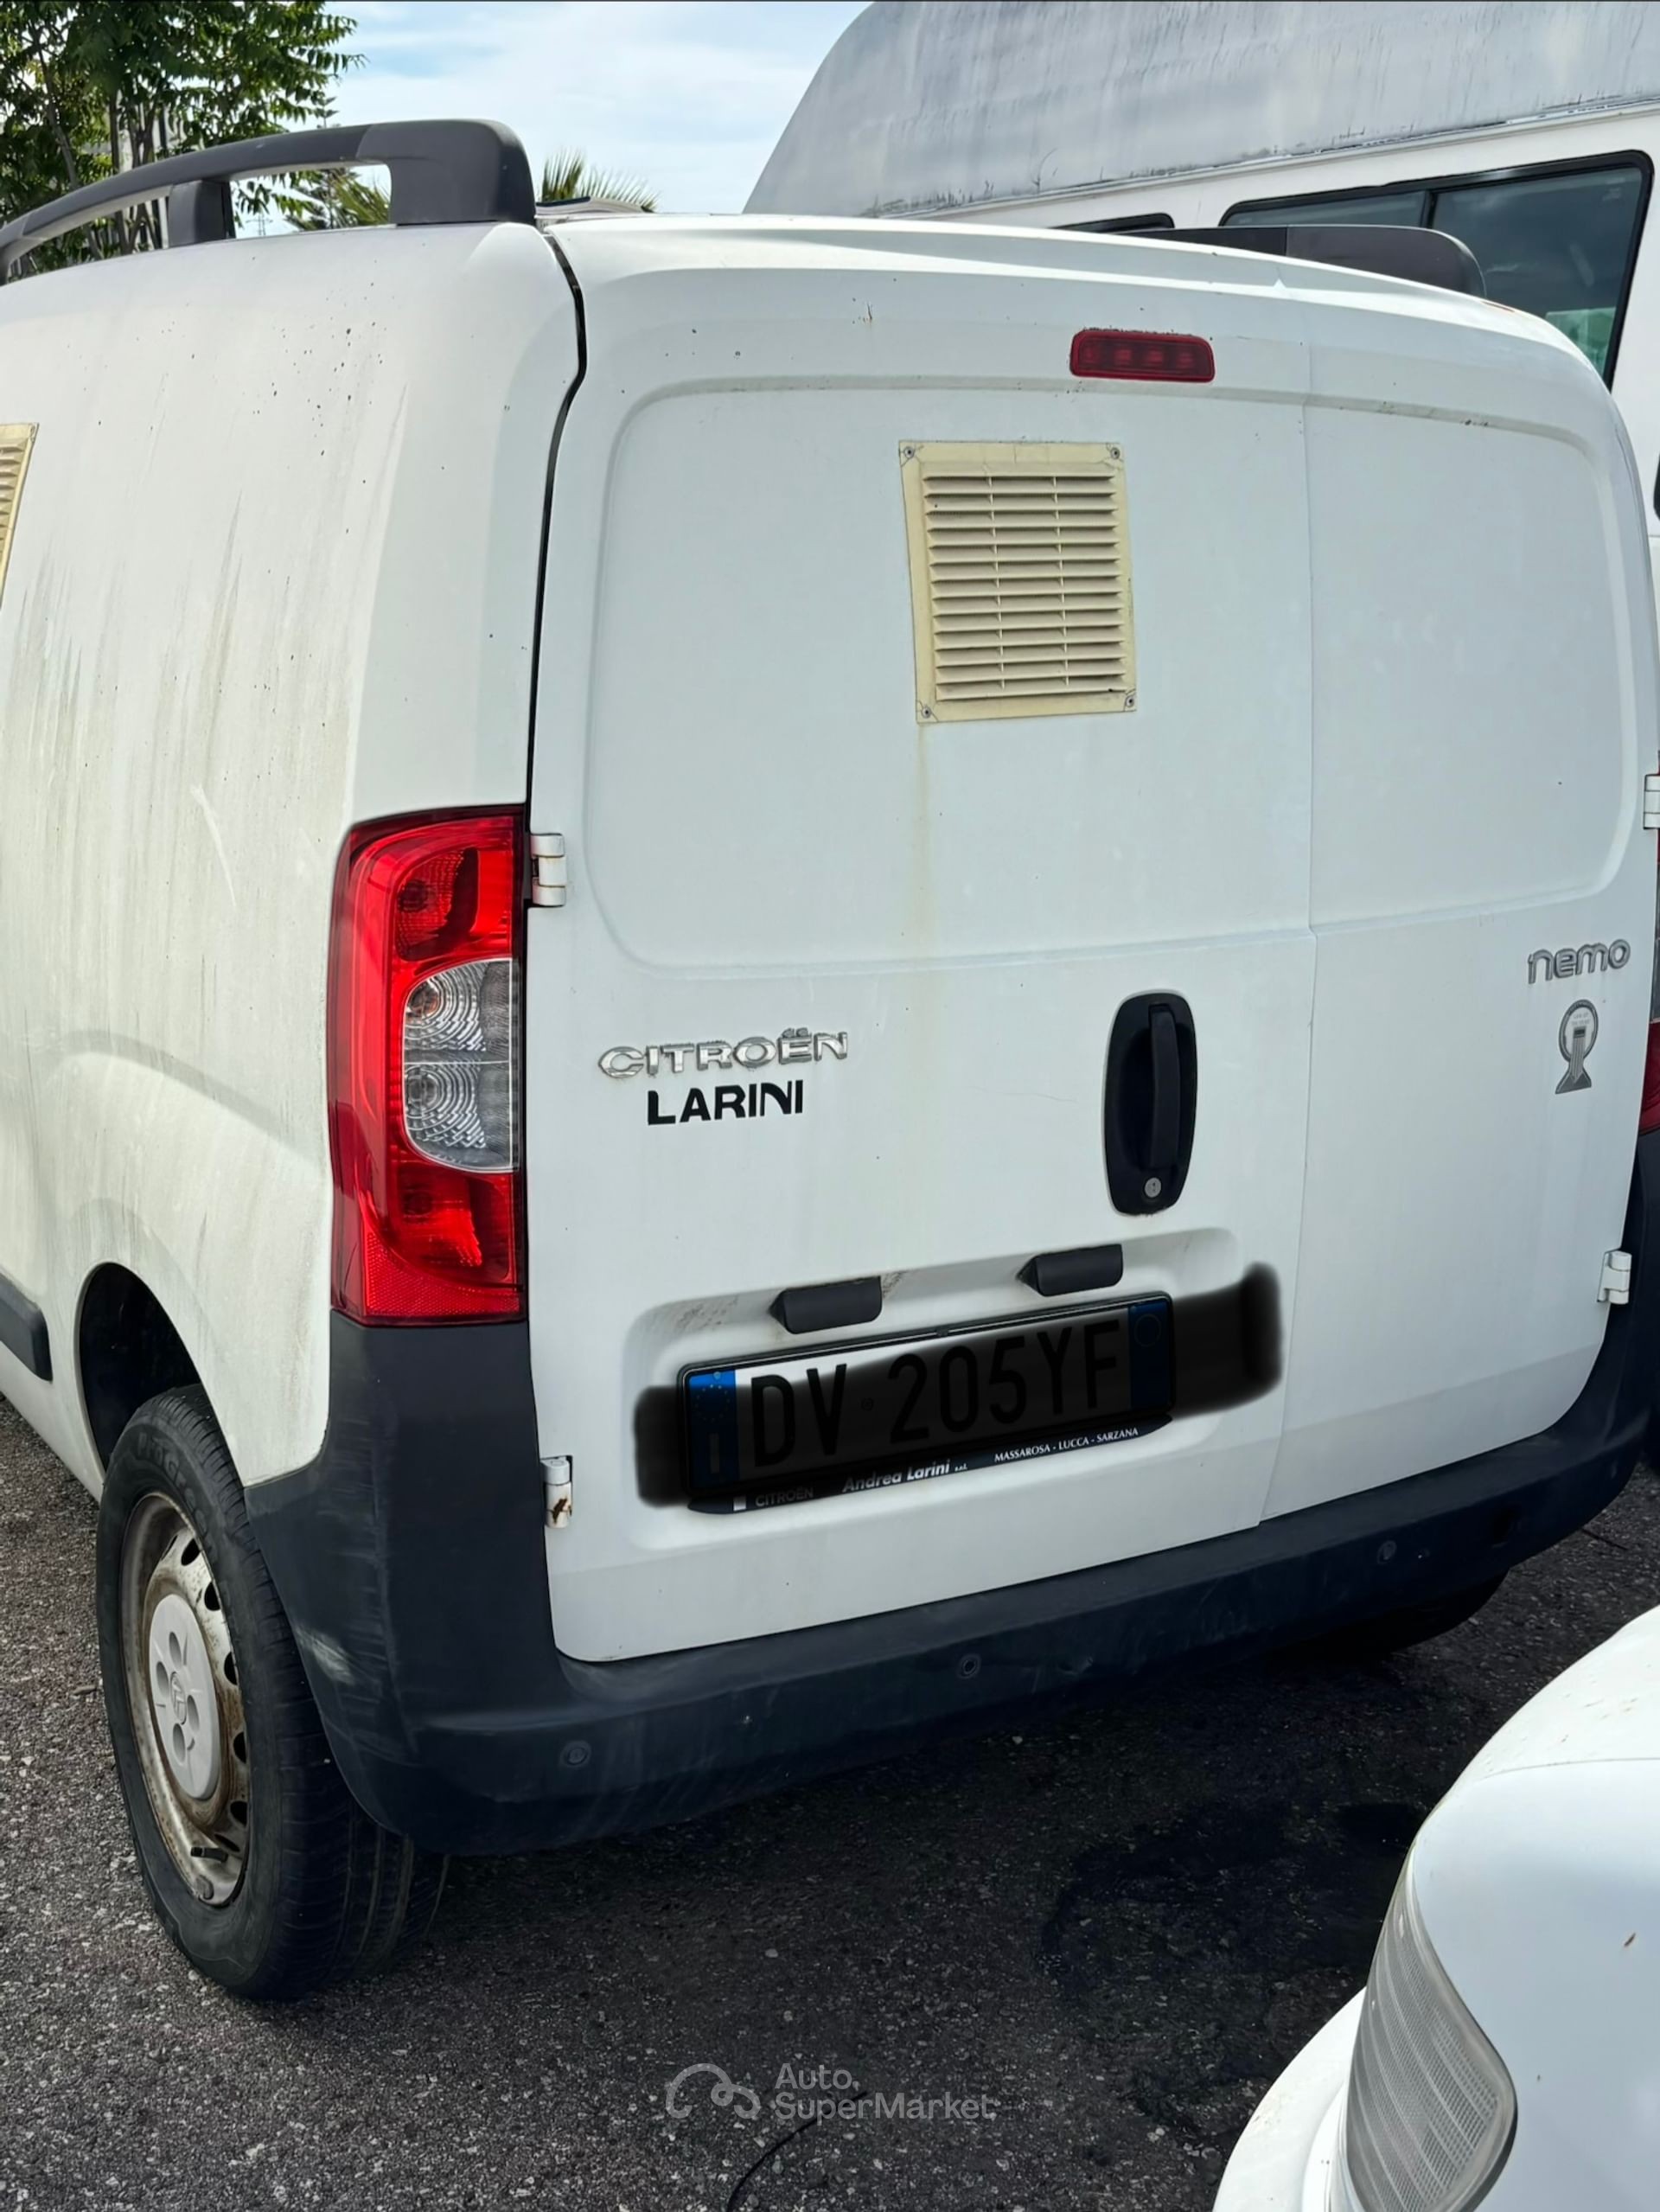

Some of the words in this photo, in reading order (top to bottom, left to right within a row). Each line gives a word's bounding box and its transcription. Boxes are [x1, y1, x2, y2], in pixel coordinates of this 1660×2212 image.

[1528, 939, 1631, 984] nemo
[597, 1027, 848, 1079] CITROËN
[648, 1080, 803, 1125] LARINI
[751, 1364, 847, 1467] DV
[889, 1320, 1120, 1442] 205YF
[994, 1445, 1050, 1462] MASSAROSA
[1058, 1438, 1089, 1451] LUCCA
[1097, 1427, 1139, 1443] SARZANA
[842, 1466, 902, 1493] Andrea
[907, 1460, 950, 1482] Larini
